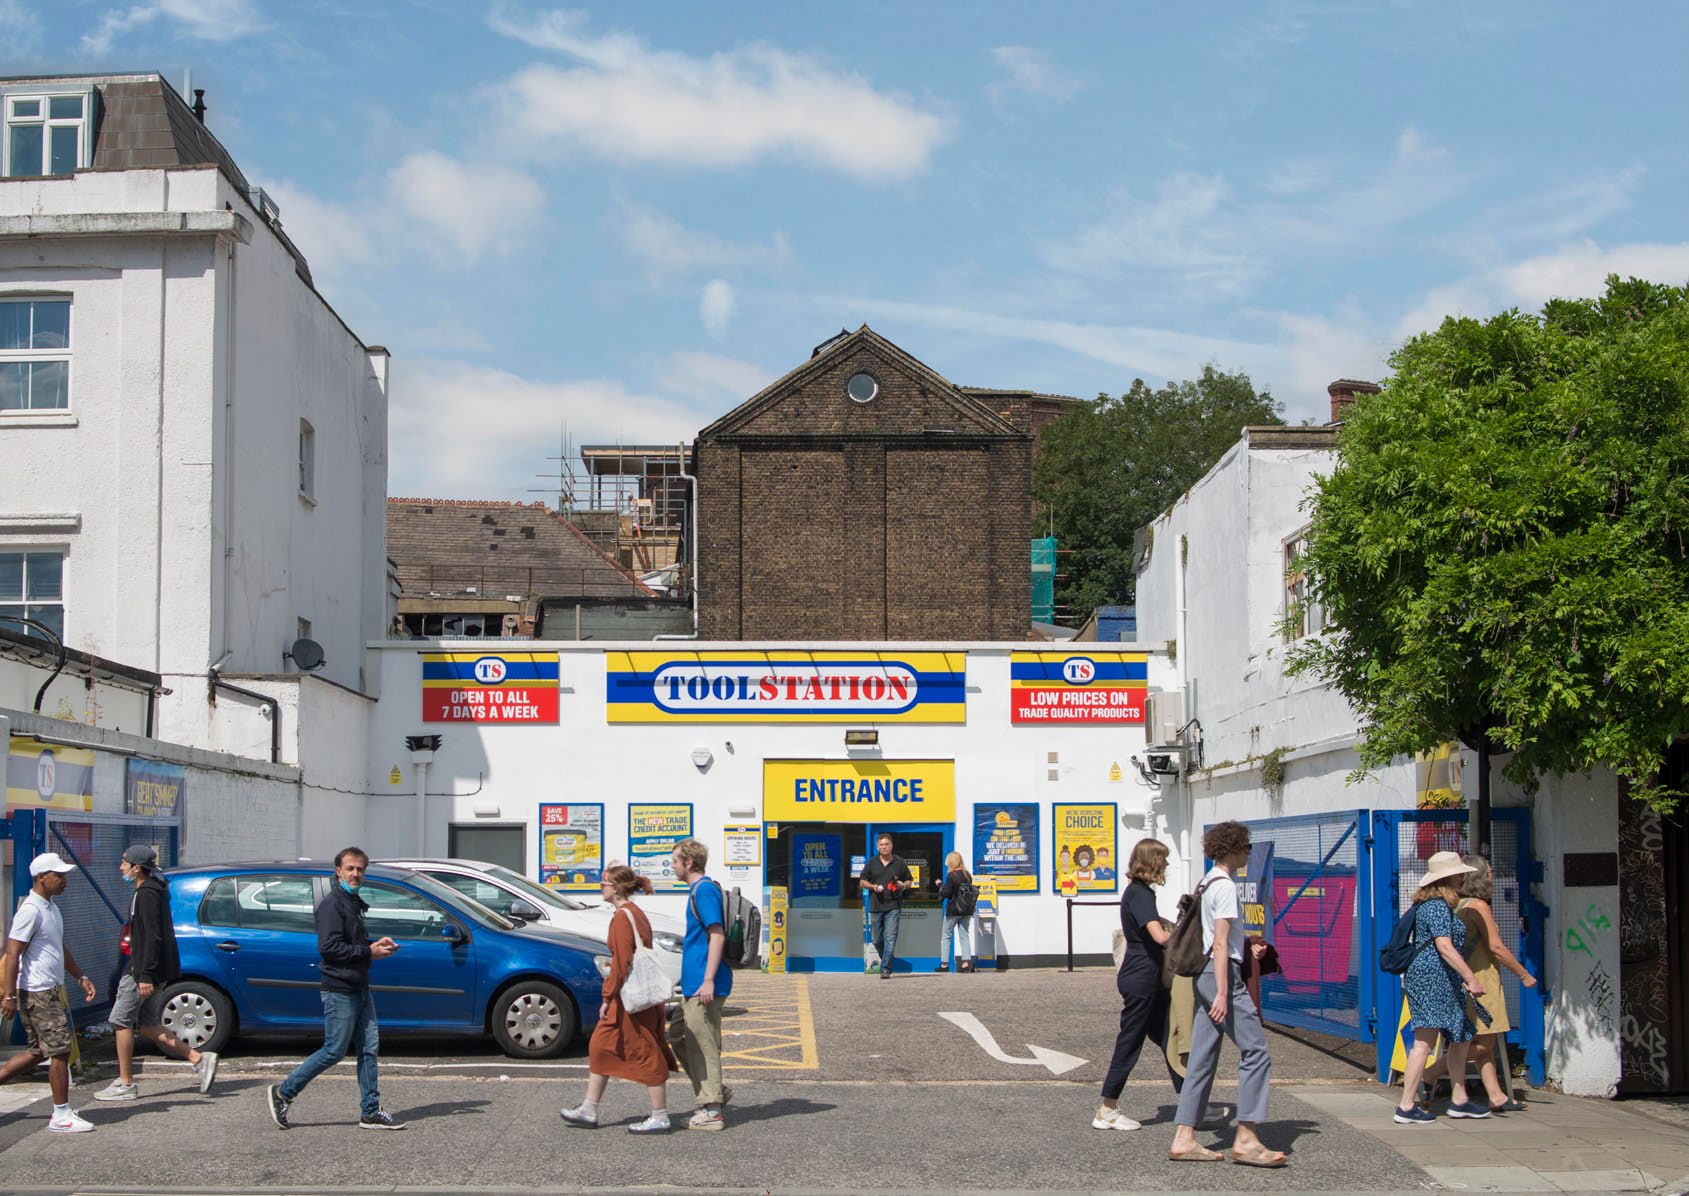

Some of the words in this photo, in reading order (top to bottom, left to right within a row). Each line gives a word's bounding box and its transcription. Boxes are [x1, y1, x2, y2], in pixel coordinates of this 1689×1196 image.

[480, 664, 502, 678] TS
[1068, 664, 1091, 679] TS
[663, 676, 910, 701] TOOLSTATION
[451, 691, 485, 704] OPEN
[488, 691, 504, 704] TO
[507, 691, 530, 704] ALL
[1030, 692, 1060, 706] LOW
[1062, 692, 1107, 706] PRICES
[1110, 692, 1128, 706] ON
[442, 706, 450, 719] 7
[453, 706, 487, 719] DAYS
[489, 706, 499, 719] A
[502, 706, 539, 719] WEEK
[1019, 708, 1049, 719] TRADE
[1051, 708, 1089, 719] QUALITY
[1091, 708, 1140, 719] PRODUCTS
[40, 763, 53, 788] TS
[795, 779, 924, 803] ENTRANCE
[545, 814, 564, 823] 25%
[1065, 816, 1104, 828] CHOICE
[804, 842, 826, 851] OPEN
